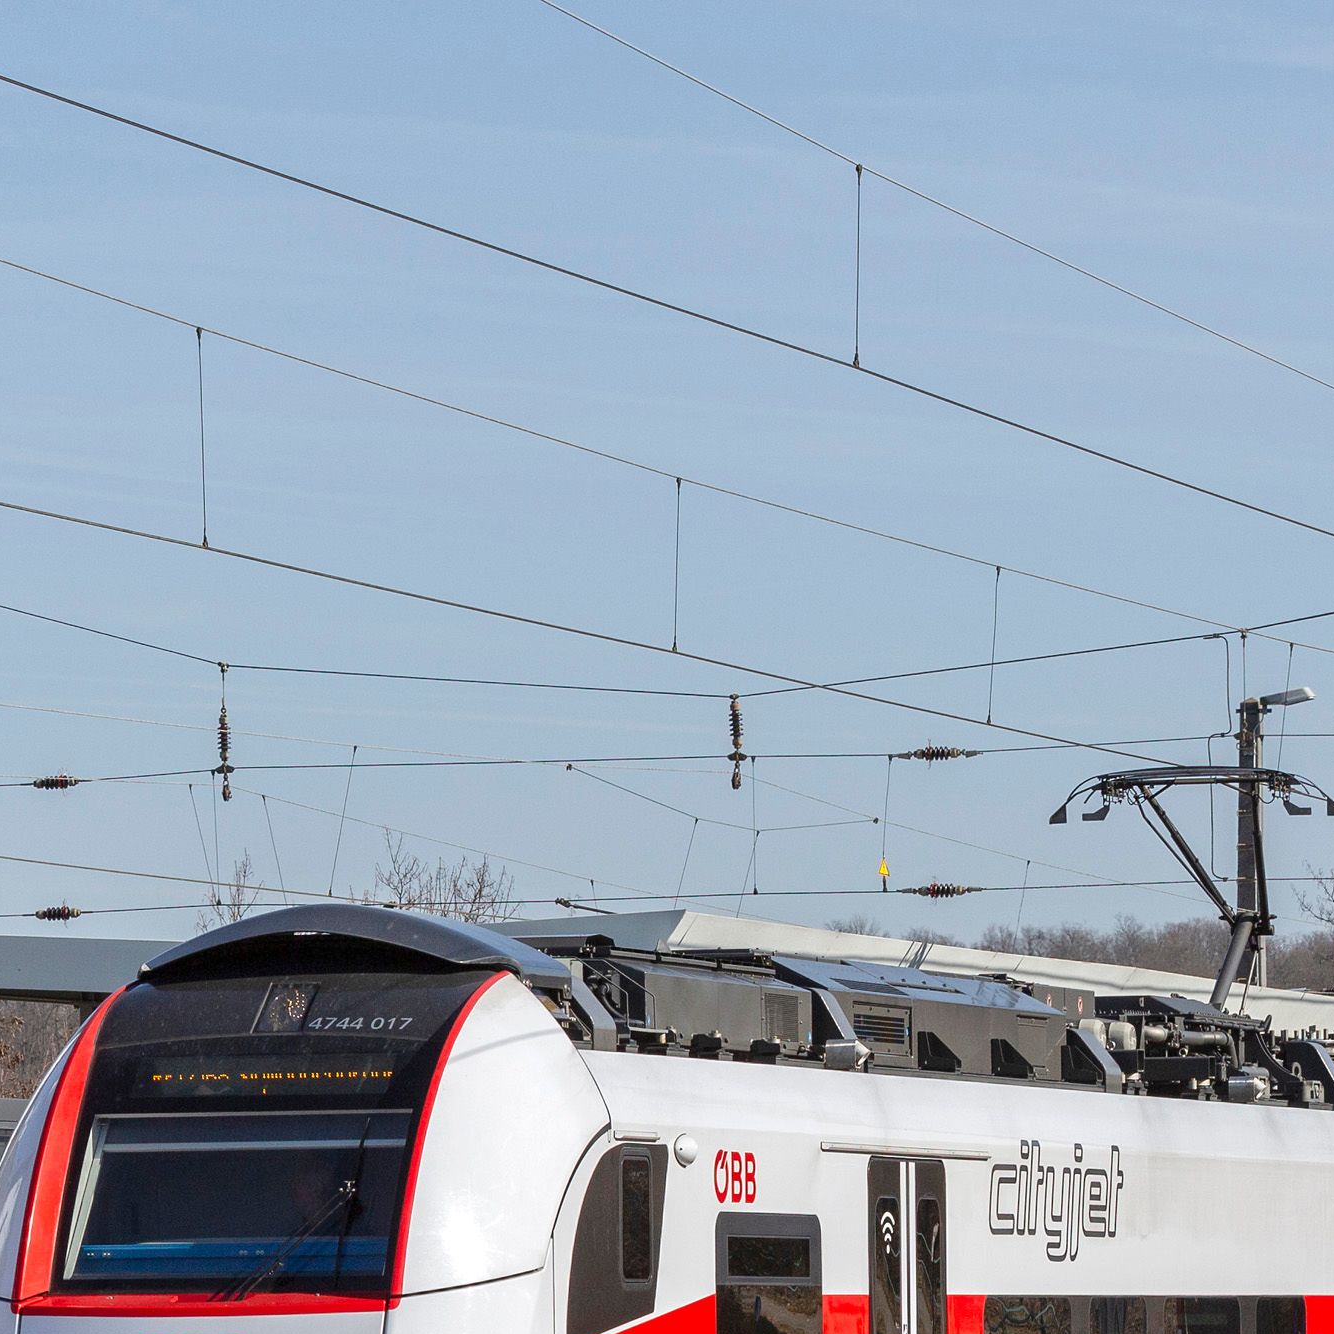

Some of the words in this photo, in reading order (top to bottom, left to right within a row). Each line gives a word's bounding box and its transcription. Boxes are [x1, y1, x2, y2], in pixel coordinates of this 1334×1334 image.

[308, 1017, 364, 1030] 4744
[370, 1017, 413, 1030] 017
[713, 1149, 757, 1204] ÖBB
[989, 1139, 1124, 1262] cityjet
